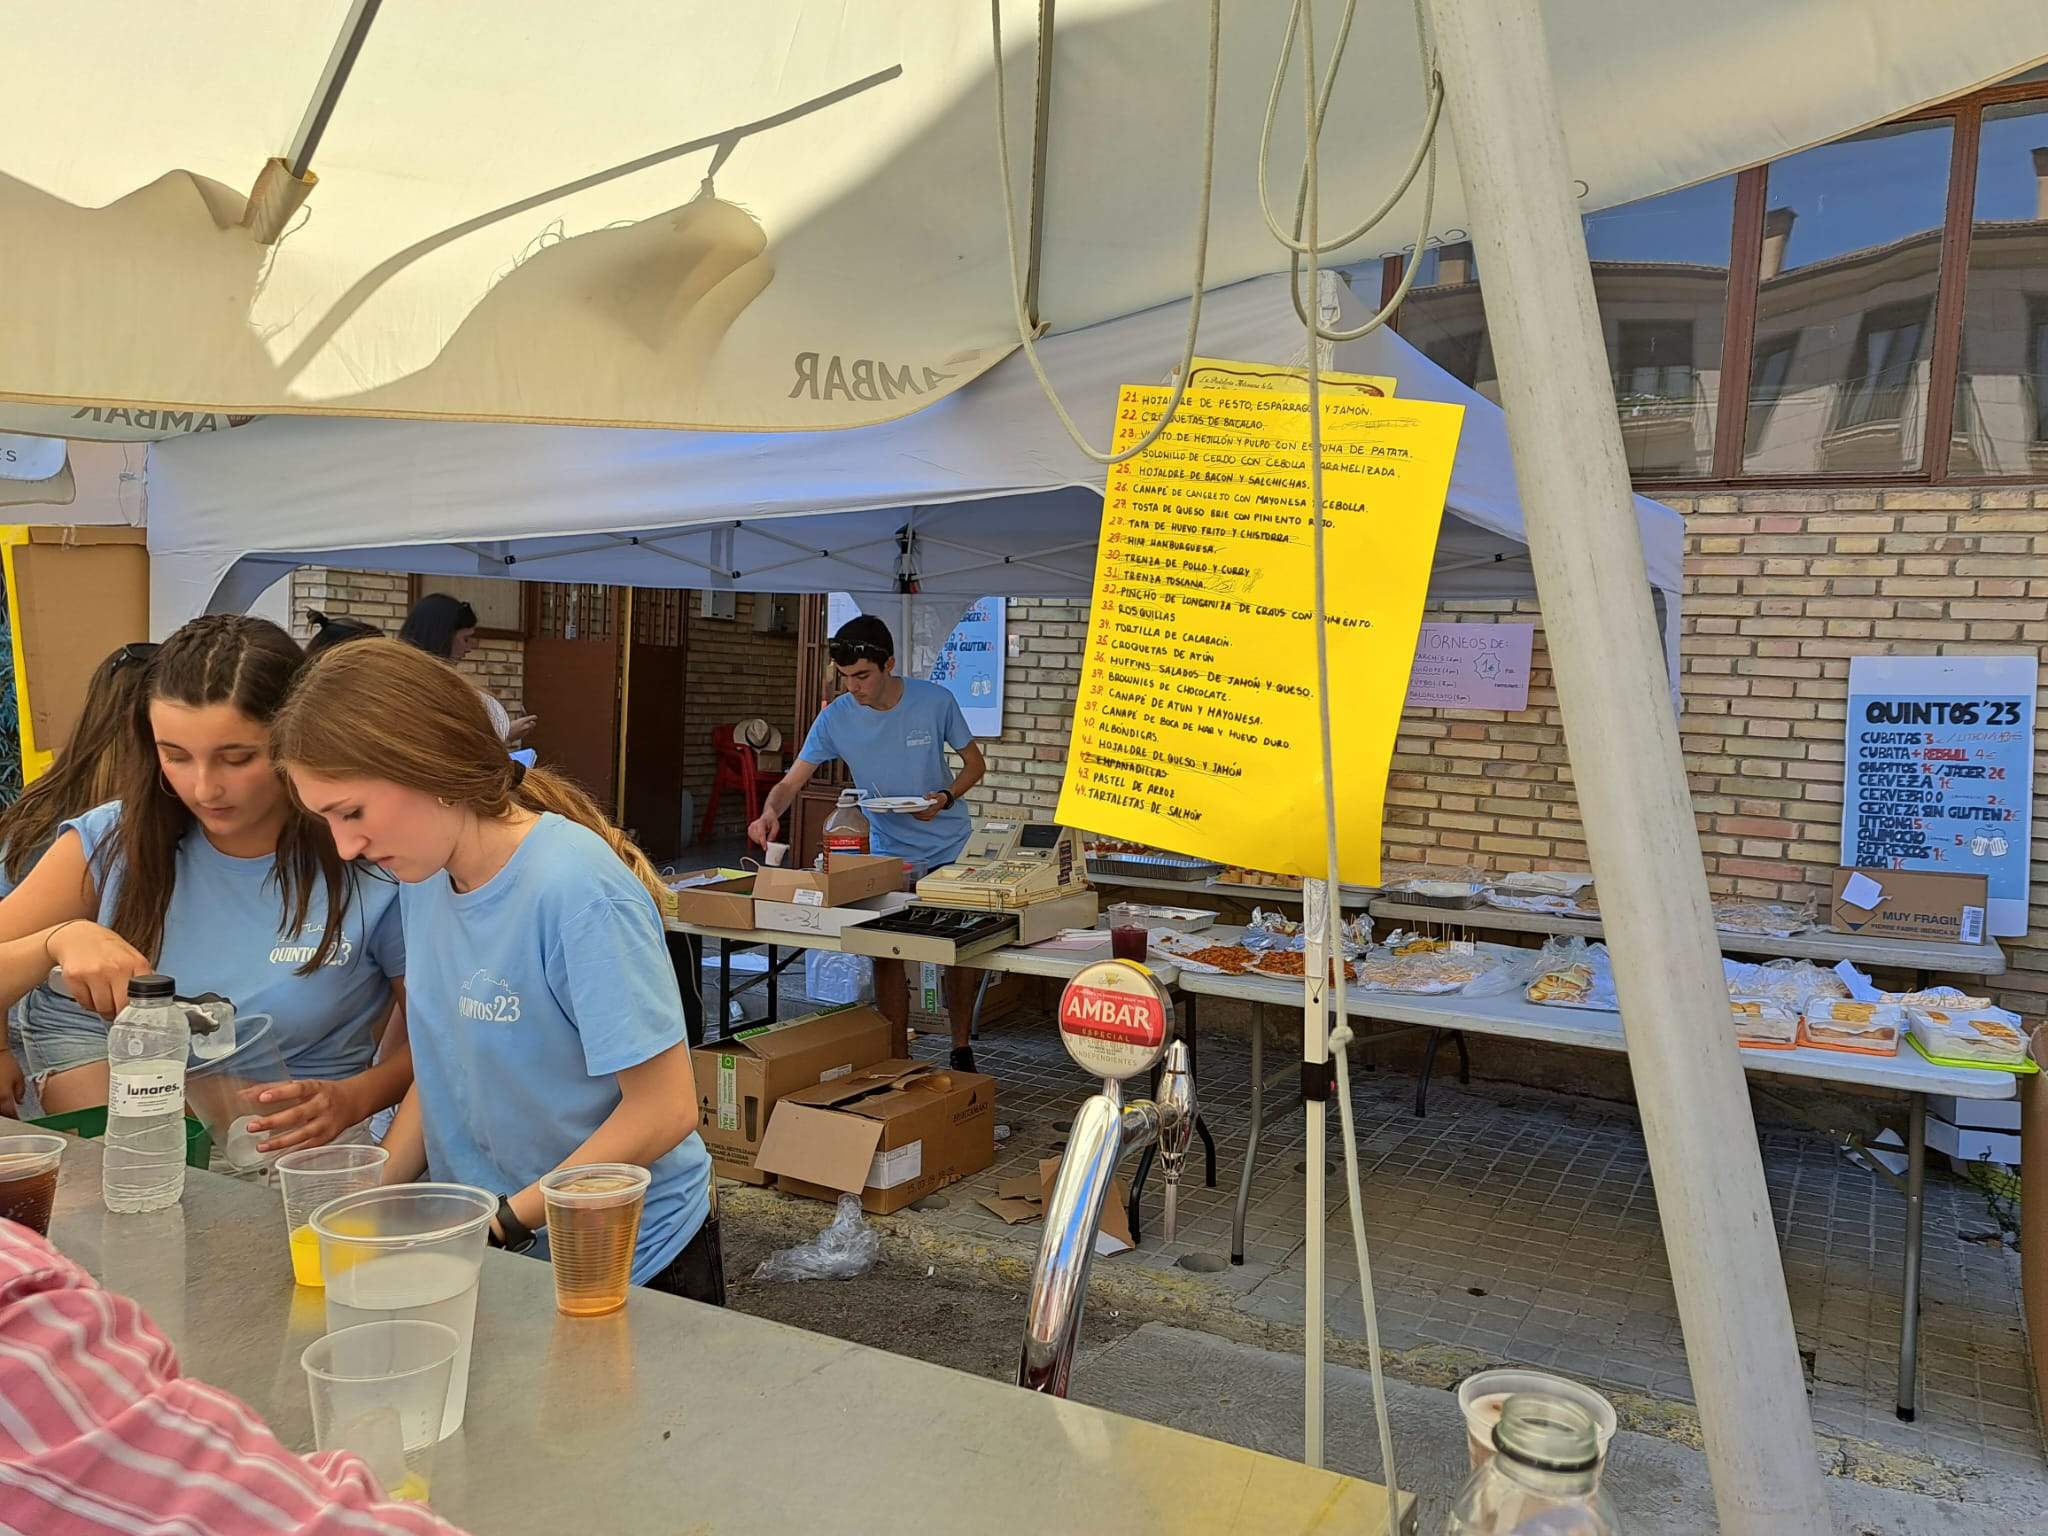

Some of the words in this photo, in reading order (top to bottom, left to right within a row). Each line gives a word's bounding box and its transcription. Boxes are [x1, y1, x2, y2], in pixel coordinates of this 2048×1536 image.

[1200, 397, 1212, 408] DE
[1325, 405, 1330, 414] Y
[1208, 416, 1219, 426] DE
[1177, 430, 1188, 441] DE
[1236, 438, 1242, 446] Y
[1244, 440, 1271, 450] PULPO
[1275, 441, 1297, 451] CON
[1350, 444, 1365, 455] DE
[1188, 452, 1199, 461] DE
[1203, 453, 1236, 464] CERDO
[1240, 456, 1261, 466] CON
[1265, 457, 1306, 469] CEBOLLA
[1139, 467, 1185, 479] HOJALDRE
[1190, 471, 1200, 480] DE
[1204, 472, 1233, 483] BACON
[1240, 473, 1245, 482] Y
[1172, 487, 1182, 496] DE
[1185, 489, 1230, 501] CANGREJO
[1234, 494, 1250, 503] CON
[1255, 494, 1307, 507] MAYONESA
[1132, 502, 1158, 512] TOSTA
[1162, 504, 1172, 514] DE
[1176, 504, 1205, 517] QUESO
[1210, 508, 1229, 519] BRIE
[1233, 513, 1250, 521] CON
[1308, 518, 1336, 529] RJO.
[1128, 519, 1149, 529] TAPA
[1154, 521, 1165, 531] DE
[1171, 523, 1197, 534] HUEVO
[1201, 526, 1226, 537] FRITO
[1232, 528, 1237, 538] Y
[1124, 553, 1160, 566] TRENZA
[1165, 558, 1177, 568] DE
[1183, 560, 1208, 572] POLLO
[1212, 564, 1218, 573] Y
[1221, 564, 1250, 577] CURRY
[1124, 570, 1161, 583] TRENZA
[1118, 603, 1176, 622] ROSQUILLAS
[1120, 586, 1157, 601] PINCHO
[1164, 593, 1176, 604] DE
[1182, 596, 1231, 611] LONGANIZA
[1239, 603, 1251, 614] DE
[1255, 605, 1287, 618] GRAUS
[1291, 611, 1312, 621] CON
[1115, 622, 1160, 637] TORTILLA
[1164, 630, 1177, 640] DE
[1420, 629, 1487, 650] TORNEOS
[1111, 639, 1168, 655] CROQUETAS
[1173, 648, 1186, 659] DE
[1108, 671, 1155, 688] BROWNIES
[1159, 682, 1170, 691] DE
[1110, 655, 1151, 671] MUFFINS
[1159, 664, 1200, 679] SALADOS
[1207, 671, 1221, 682] DE
[1266, 680, 1273, 690] Y
[1151, 697, 1164, 709] DE
[1197, 705, 1203, 715] Y
[1143, 714, 1155, 724] DE
[1160, 717, 1179, 729] BOCA
[1182, 722, 1193, 732] DE
[1218, 728, 1223, 737] Y
[1229, 729, 1258, 744] HUEVO
[1860, 731, 1922, 745] CUBATAS
[1098, 738, 1148, 758] HOJALDRE
[1152, 750, 1164, 762] DE
[1167, 753, 1196, 768] QUESO
[1203, 761, 1208, 770] Y
[1859, 746, 1911, 760] CUBATA
[1857, 761, 1918, 774] CHUPITOS
[1988, 767, 2006, 780] 2€
[1093, 772, 1126, 787] PASTEL
[1132, 780, 1142, 792] DE
[1147, 783, 1175, 799] ARROZ
[1858, 773, 1933, 789] CERVEZA
[1087, 788, 1145, 810] TARTALETAS
[1150, 801, 1161, 814] DE
[1859, 787, 1925, 804] CERVEZA
[1858, 801, 1920, 818] CERVEZA
[1921, 805, 1944, 818] SIN
[1948, 806, 2003, 822] GLUTEN
[1858, 815, 1913, 830] LITRONA
[1857, 828, 1926, 845] CALIMOCHO
[1857, 840, 1932, 859] REFRESCOS
[1855, 855, 1889, 868] AGUA
[1882, 911, 1911, 922] MUY
[1066, 995, 1154, 1031] AMBAR
[1082, 1028, 1130, 1043] ESPECIAL
